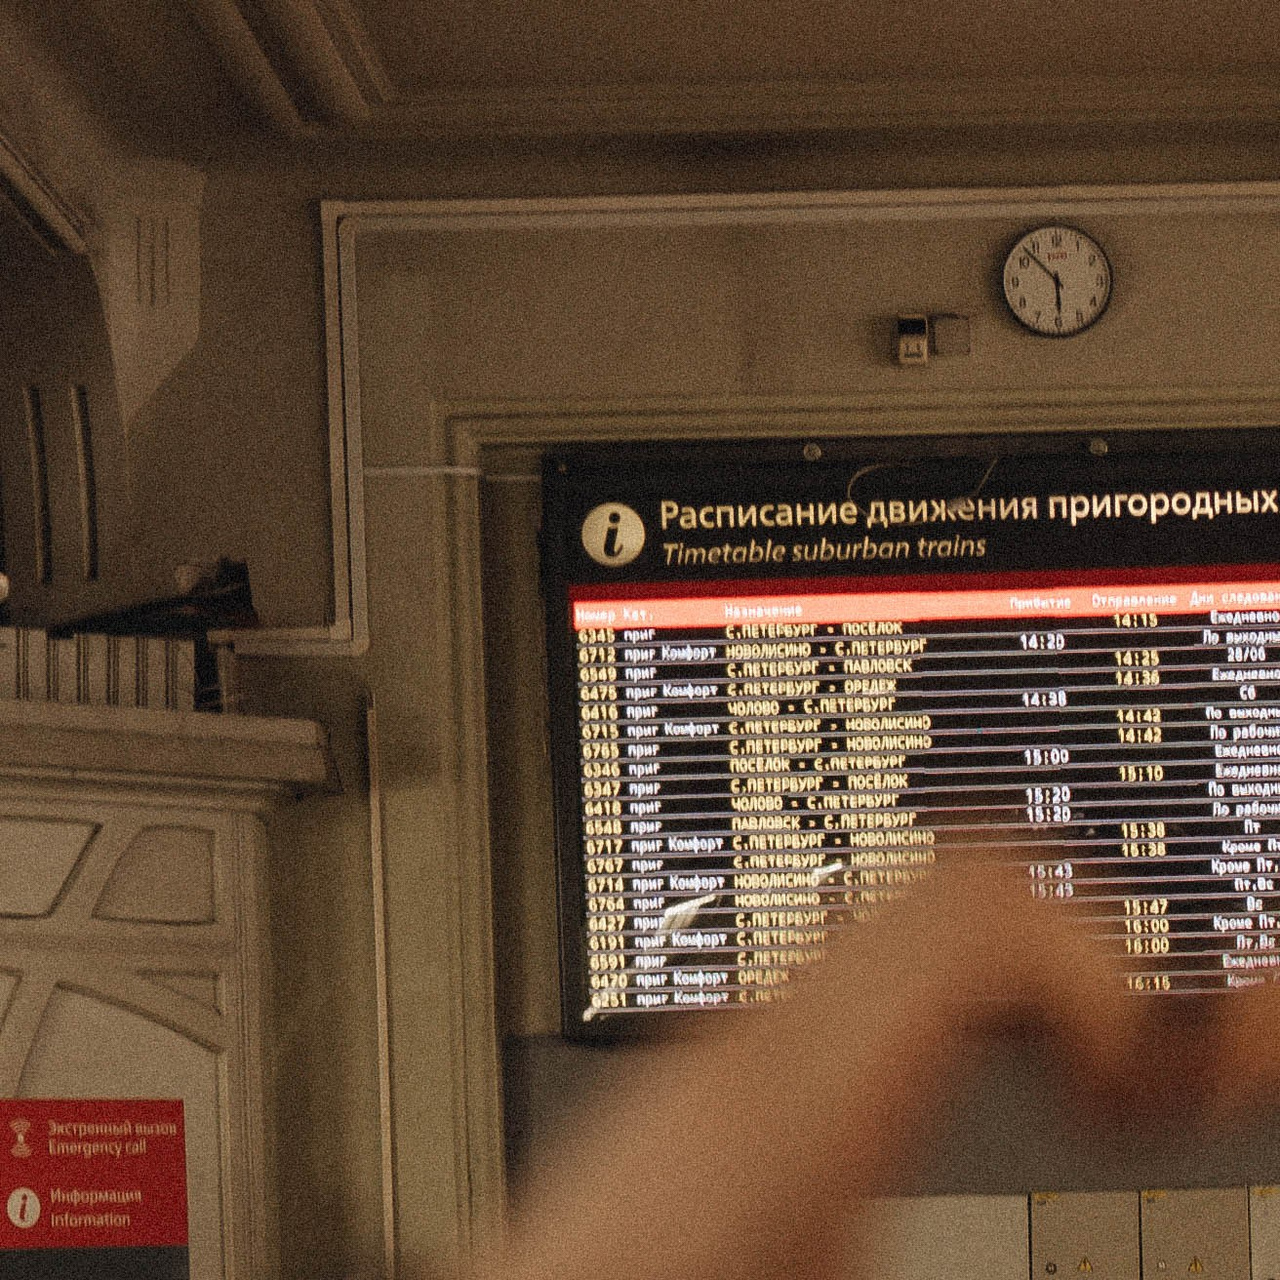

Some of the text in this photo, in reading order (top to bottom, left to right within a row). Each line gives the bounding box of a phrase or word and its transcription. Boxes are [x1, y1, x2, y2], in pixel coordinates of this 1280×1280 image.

[660, 499, 857, 530] Расписание
[866, 495, 1037, 528] движения
[1049, 489, 1277, 526] пригородных
[662, 535, 986, 566] Timetable suburban trains
[624, 628, 655, 644] приг
[726, 623, 817, 640] С.ПЕТЕРБУРГ
[1211, 611, 1280, 626] Ежедневно
[579, 646, 615, 663] 6712
[624, 649, 655, 664] приг
[661, 644, 716, 661] Комфорт
[726, 642, 811, 660] НОВОЛИСИНО
[835, 638, 927, 657] С.ПЕТЕРБУРГ
[1020, 633, 1065, 650] 14:20
[1203, 629, 1219, 645] По
[625, 667, 656, 683] приг
[727, 660, 819, 678] С.ПЕТЕРБУРГ
[843, 658, 912, 674] ПАВЛОВСК
[625, 687, 657, 702] приг
[662, 683, 718, 700] Комфорт
[727, 680, 820, 697] С.ПЕТЕРБУРГ
[844, 678, 896, 696] ОРЕДЕЖ
[626, 706, 658, 721] приг
[728, 700, 780, 717] ЧОЛОВО
[803, 697, 895, 714] С.ПЕТЕРБУРГ
[627, 726, 658, 740] приг
[664, 721, 719, 738] Комфорт
[728, 719, 821, 735] С.ПЕТЕРБУРГ
[845, 715, 931, 731] НОВОЛИСИНО
[1205, 705, 1222, 719] По
[628, 744, 659, 760] приг
[729, 738, 822, 756] С.ПЕТЕРБУРГ
[846, 735, 932, 751] НОВОЛИСИНО
[1210, 724, 1227, 740] По
[628, 762, 660, 779] приг
[814, 754, 906, 771] С.ПЕТЕРБУРГ
[1024, 747, 1069, 766] 15:00
[629, 782, 661, 799] приг
[731, 776, 823, 794] С.ПЕТЕРБУРГ
[629, 801, 661, 817] приг
[731, 795, 783, 812] ЧОЛОВО
[807, 793, 899, 810] С.ПЕТЕРБУРГ
[1026, 785, 1071, 805] 15:20
[1208, 780, 1225, 797] По
[630, 821, 662, 836] приг
[732, 815, 800, 831] ПАВЛОВСК
[824, 812, 916, 830] С.ПЕТЕРБУРГ
[1213, 801, 1230, 817] По
[586, 838, 623, 856] 6717
[631, 840, 663, 856] приг
[668, 835, 723, 854] Комфорт
[733, 832, 825, 851] С.ПЕТЕРБУРГ
[850, 830, 935, 847] НОВОЛИСИНО
[1244, 818, 1261, 834] Пт
[587, 857, 623, 874] 6767
[632, 860, 663, 874] приг
[733, 853, 826, 869] С.ПЕТЕРБУРГ
[851, 850, 935, 865] НОВОЛИСИНО
[1222, 839, 1261, 856] Кроме
[587, 858, 1251, 895] 6714 приг Комфорт Кроме
[633, 897, 665, 911] приг
[635, 935, 666, 949] приг
[671, 930, 727, 950] Комфорт
[1125, 918, 1169, 934] 16:00
[1213, 915, 1253, 934] Кроме
[635, 955, 667, 972] приг
[1125, 937, 1170, 954] 16:00
[591, 974, 628, 990] 6470
[636, 974, 668, 990] приг
[673, 969, 728, 988] Комфорт
[636, 994, 668, 1009] приг
[673, 990, 729, 1007] Комфорт
[49, 1138, 146, 1158] Emergency call
[50, 1188, 141, 1206] Информация
[51, 1213, 130, 1228] Information
